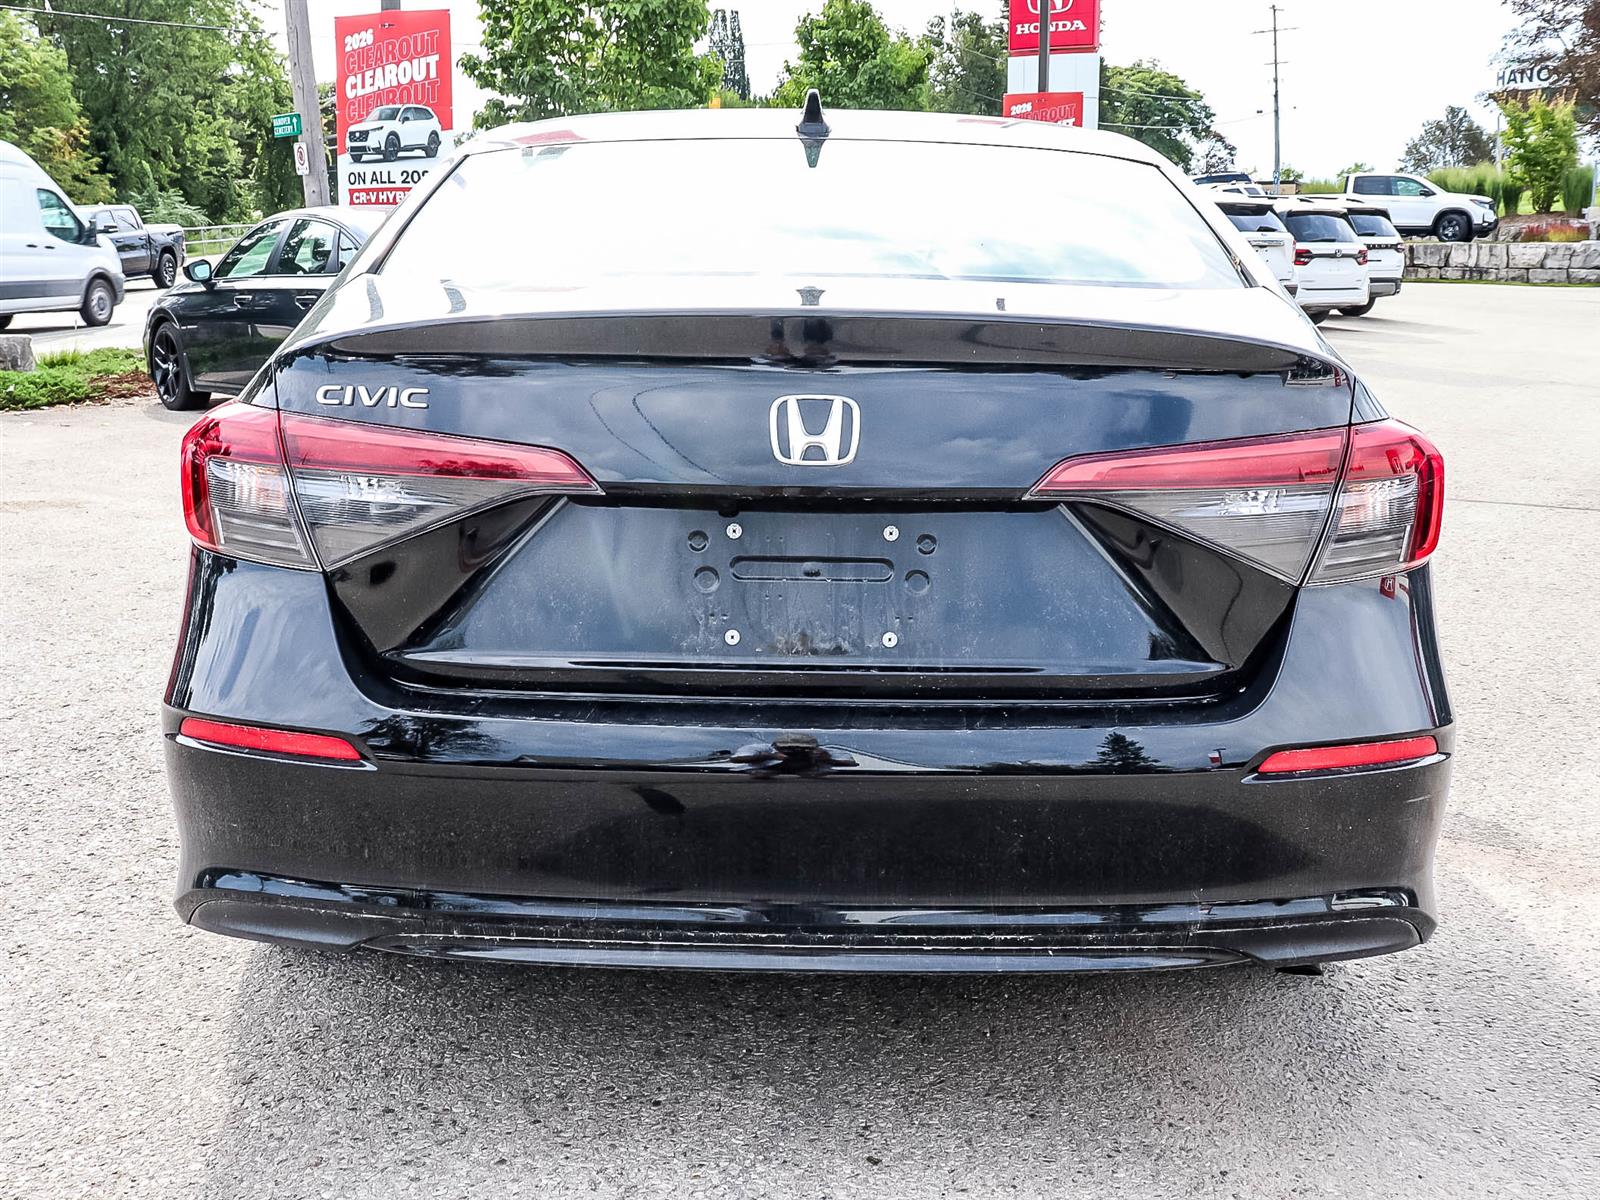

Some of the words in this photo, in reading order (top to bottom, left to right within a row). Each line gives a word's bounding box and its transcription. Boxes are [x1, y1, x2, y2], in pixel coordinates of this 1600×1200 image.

[1015, 20, 1087, 35] HONDA
[344, 28, 374, 53] 2026
[345, 29, 440, 75] CLEAROUT
[345, 54, 440, 99] CLEAROUT
[348, 172, 366, 185] ON
[370, 170, 396, 185] ALL
[352, 191, 377, 204] CR-V
[315, 385, 430, 408] CIVIC
